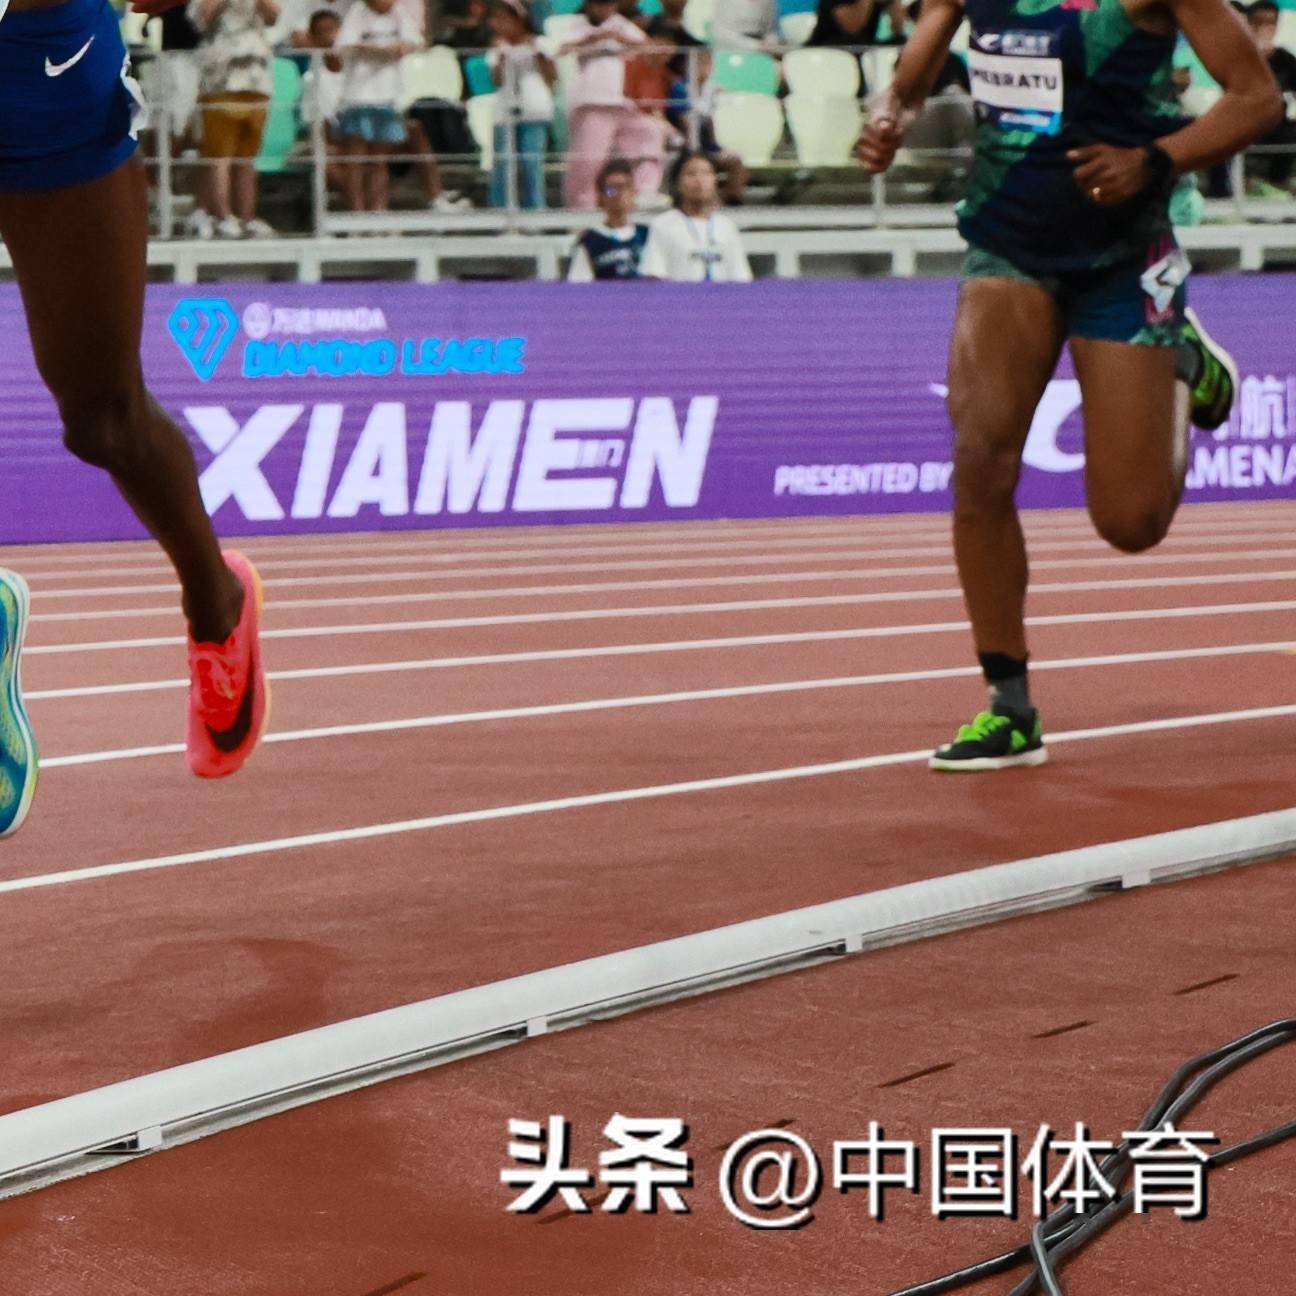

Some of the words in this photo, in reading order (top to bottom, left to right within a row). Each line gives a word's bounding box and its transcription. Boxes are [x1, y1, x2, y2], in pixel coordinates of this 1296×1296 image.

[242, 339, 397, 379] DIAMOND
[400, 336, 528, 375] LEAGUE
[182, 395, 719, 521] XIAMEN
[773, 462, 919, 495] PRESENTED
[919, 461, 955, 493] BY
